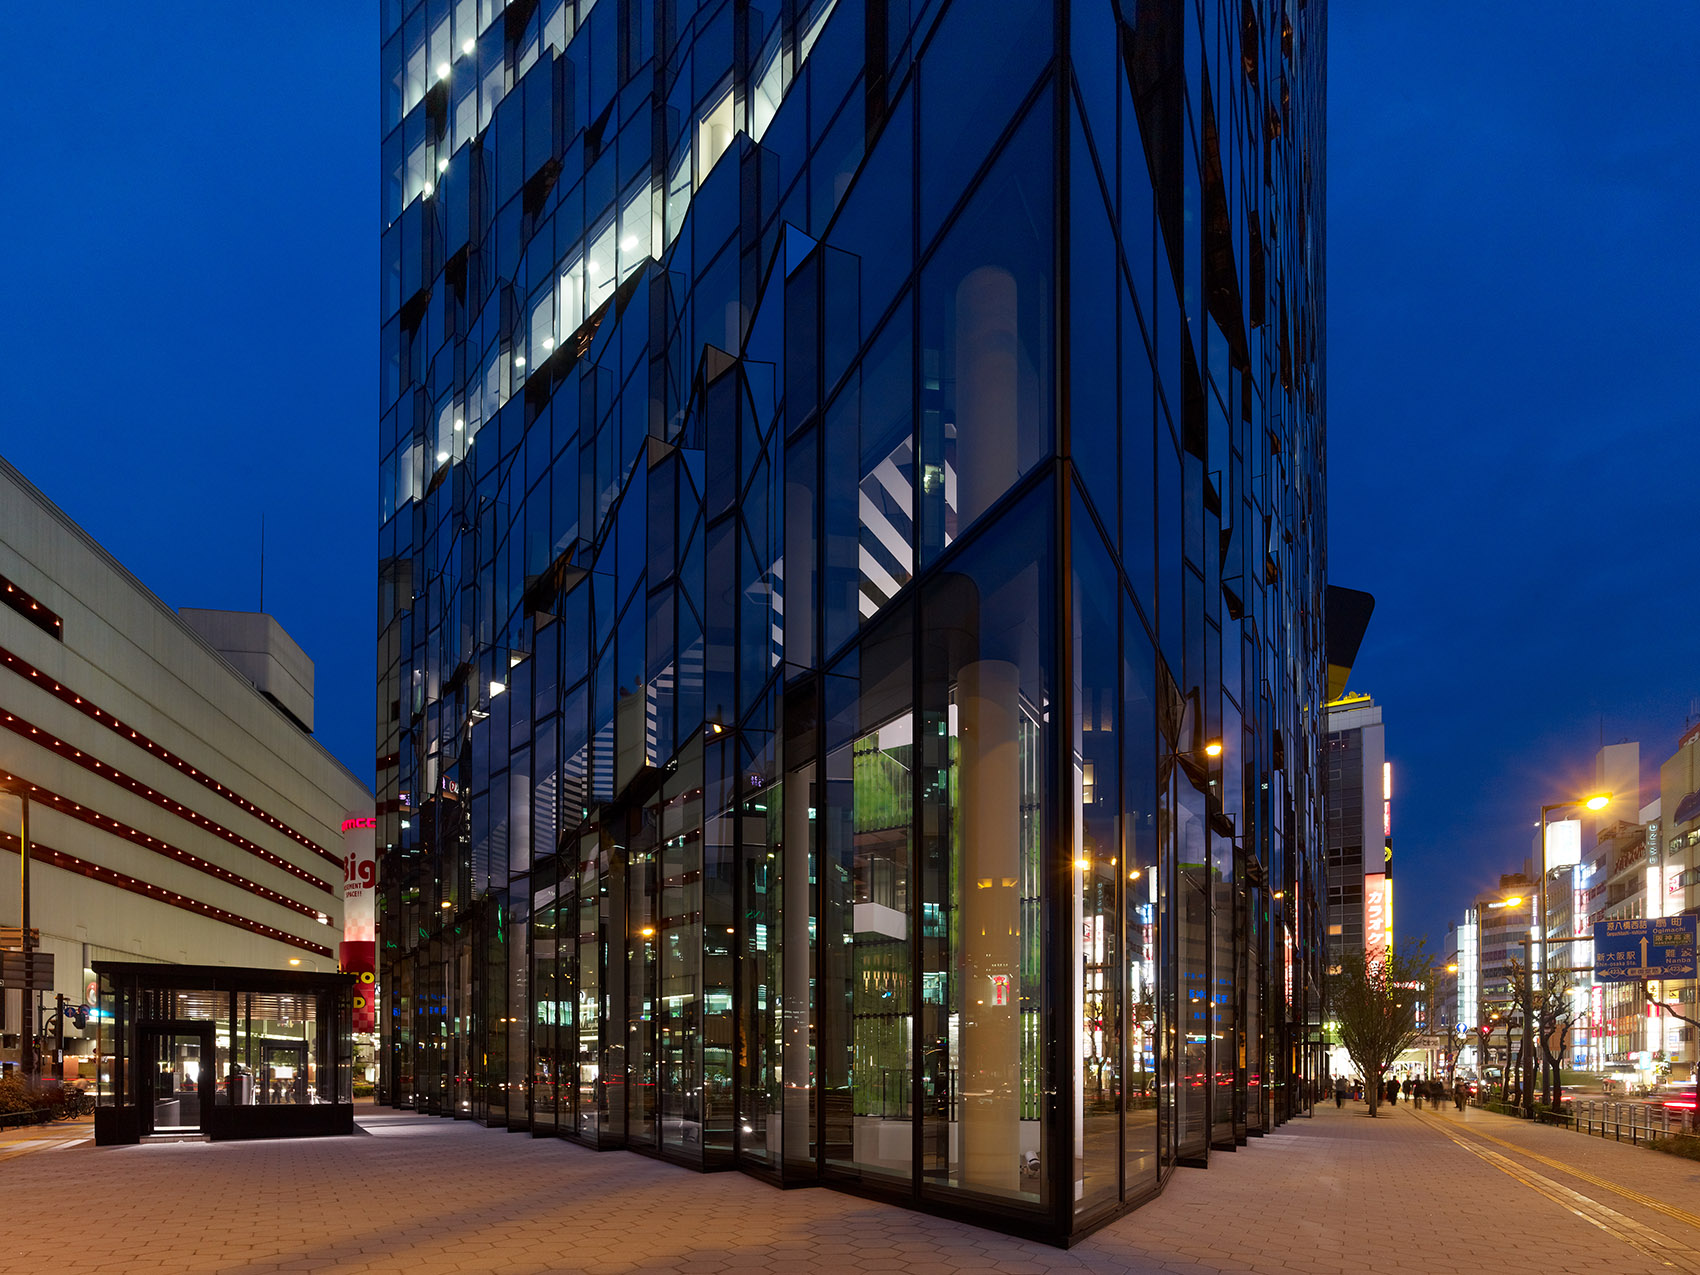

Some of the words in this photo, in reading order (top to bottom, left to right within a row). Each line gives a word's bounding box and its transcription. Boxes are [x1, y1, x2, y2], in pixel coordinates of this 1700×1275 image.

[1367, 890, 1385, 945] カラオケ
[1652, 926, 1686, 935] Ogimachi
[1596, 951, 1636, 961] 新大阪駅
